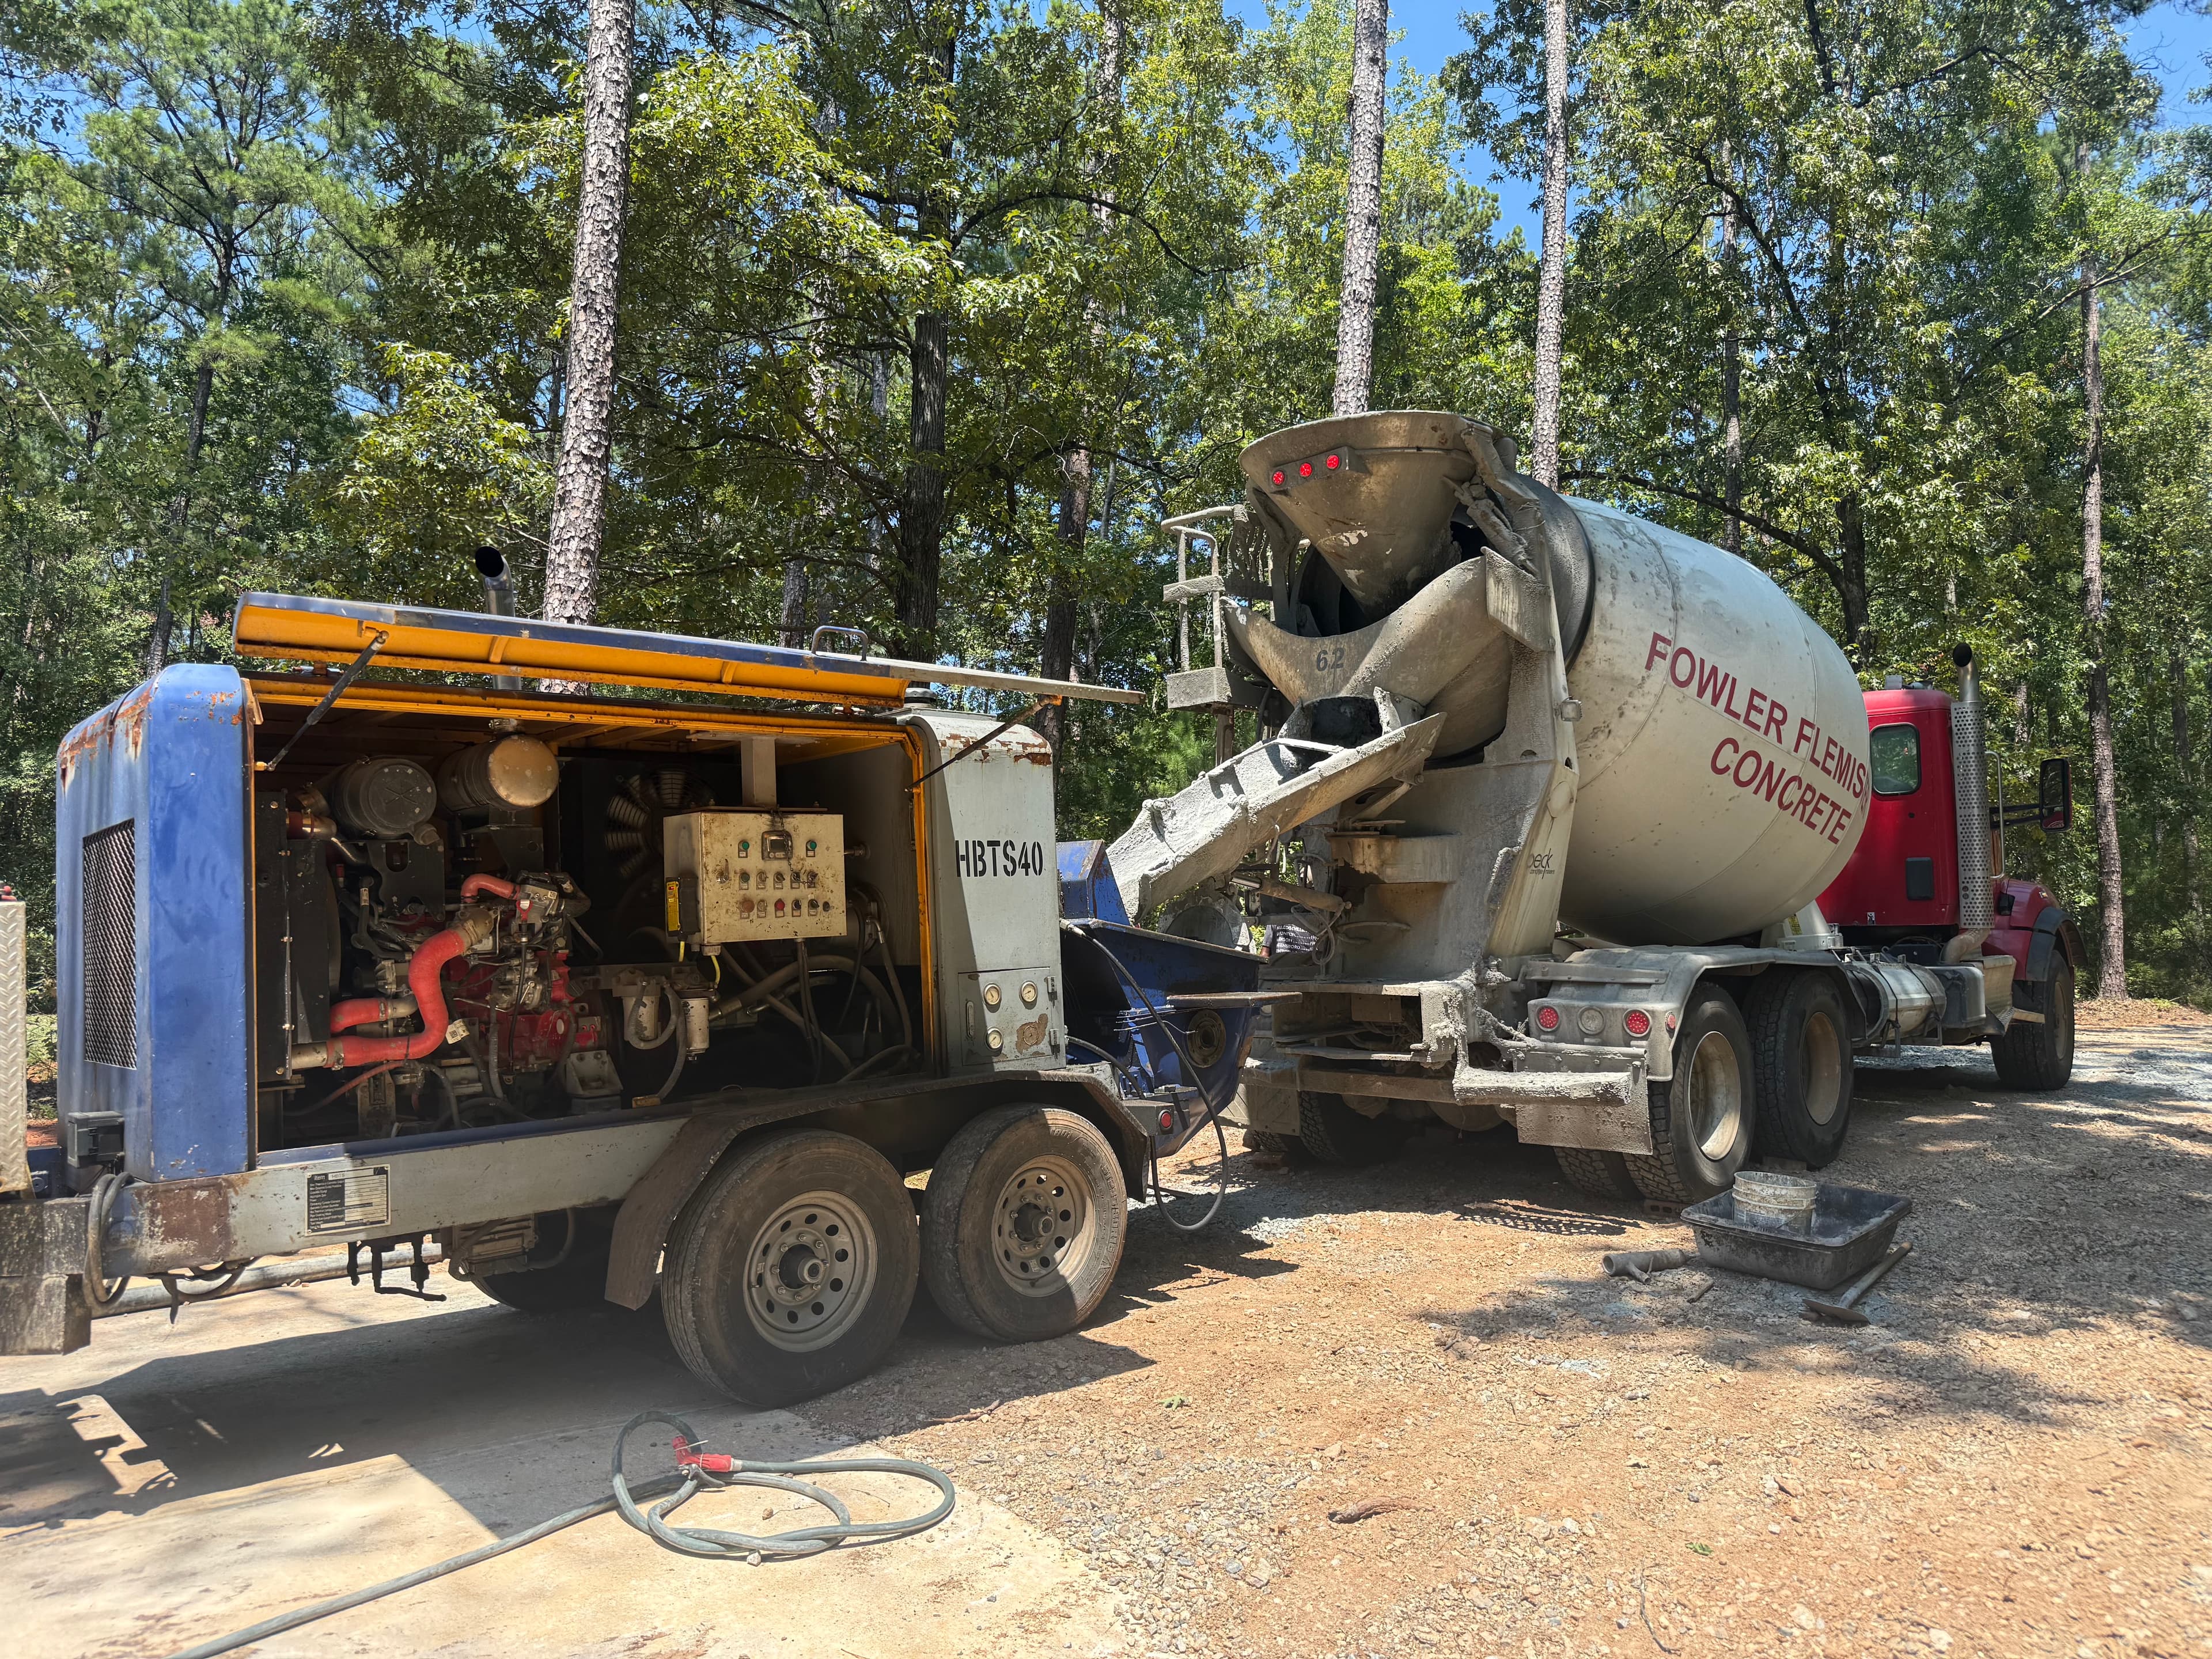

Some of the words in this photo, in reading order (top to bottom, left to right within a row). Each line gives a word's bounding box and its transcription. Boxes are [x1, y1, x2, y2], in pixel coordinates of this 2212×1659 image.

[1316, 647, 1346, 672] 62
[1645, 632, 1787, 744] FOWLER
[1794, 717, 1869, 816] FLEMIS
[1711, 738, 1851, 844] CONCRETE
[955, 840, 1043, 877] HBTS40
